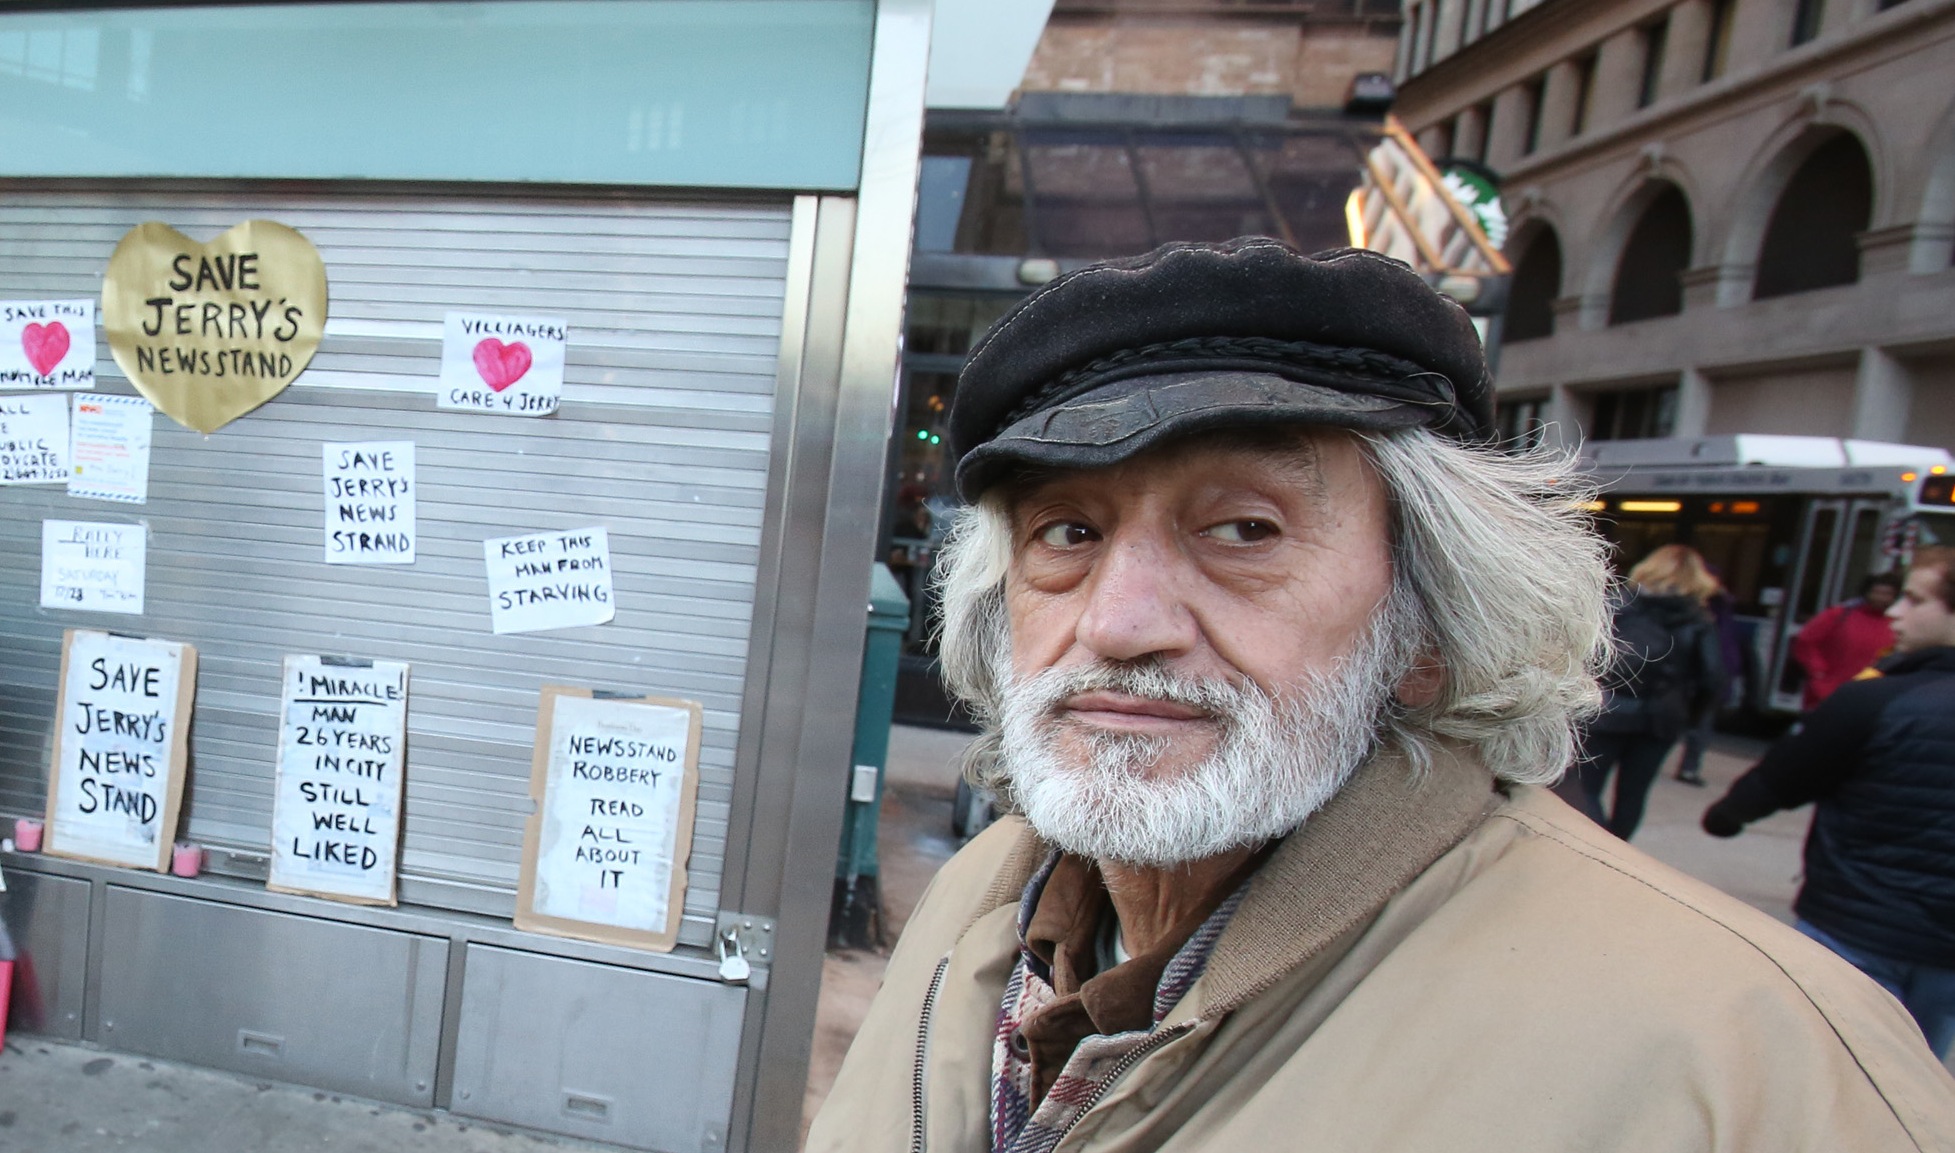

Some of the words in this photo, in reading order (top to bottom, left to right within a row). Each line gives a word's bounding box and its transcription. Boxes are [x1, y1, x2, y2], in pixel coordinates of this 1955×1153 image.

[169, 253, 260, 292] SAVE
[5, 305, 46, 322] SAVE
[143, 297, 303, 342] JERRY'S
[462, 318, 564, 341] VILLIAGERS
[136, 346, 293, 379] NEWSSTAND
[451, 388, 495, 408] CARE
[503, 395, 513, 410] 4
[338, 450, 395, 471] SAVE
[340, 504, 397, 522] NEWS
[332, 531, 410, 552] STRAND
[501, 540, 546, 558] KEEP
[558, 536, 592, 552] THIS
[515, 561, 552, 577] MAN
[558, 557, 604, 572] FROM
[499, 583, 608, 609] STARVING
[90, 657, 160, 697] SAVE
[75, 702, 166, 743] JERRY'S
[312, 706, 357, 724] MAN
[333, 730, 392, 754] YEARS
[569, 734, 677, 763] NEWSSTAND
[79, 748, 156, 778] NEWS
[316, 755, 340, 772] IN
[346, 758, 386, 781] CITY
[573, 761, 662, 789] ROBBERY
[78, 778, 157, 825] STAND
[300, 782, 370, 806] STILL
[590, 798, 644, 818] READ
[313, 811, 377, 834] WELL
[581, 825, 633, 844] ALL
[293, 837, 377, 870] LIKED
[575, 846, 642, 865] ABOUT
[600, 870, 625, 889] IT
